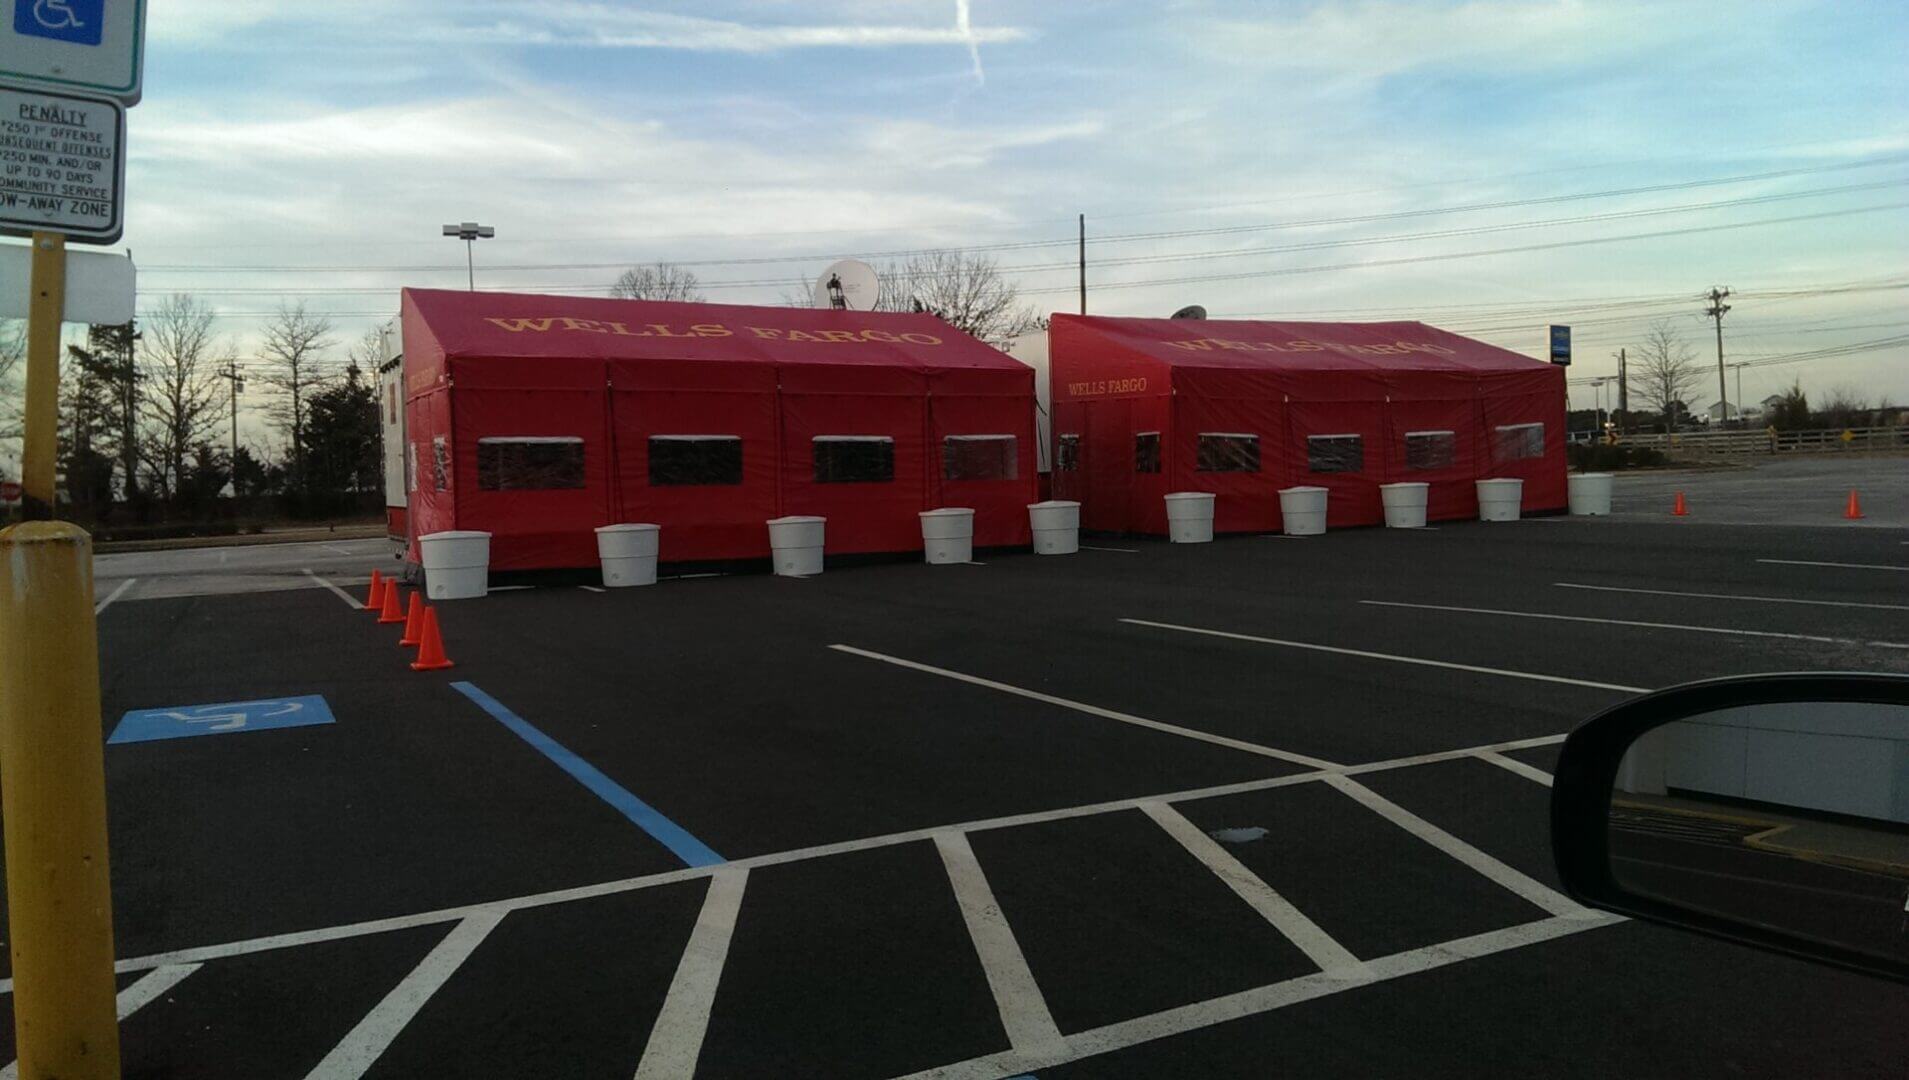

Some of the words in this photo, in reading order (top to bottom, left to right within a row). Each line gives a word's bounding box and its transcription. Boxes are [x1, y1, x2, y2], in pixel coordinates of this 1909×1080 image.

[20, 103, 87, 127] PENALTY
[50, 126, 103, 144] OFFENSE
[61, 142, 112, 159] OFFENSES
[29, 153, 51, 165] MIN.
[56, 158, 101, 171] AND/OR
[6, 164, 21, 175] UP
[27, 166, 40, 177] TO
[46, 168, 61, 180] 90
[66, 171, 93, 184] DAYS
[61, 183, 108, 199] SERVICE
[70, 200, 108, 217] ZONE
[484, 317, 733, 338] WELLS
[744, 326, 943, 345] FARGO
[1160, 338, 1325, 352] WELLS
[1323, 342, 1456, 355] FARGO
[1068, 381, 1105, 396] WELLS
[1108, 377, 1147, 393] FARGO
